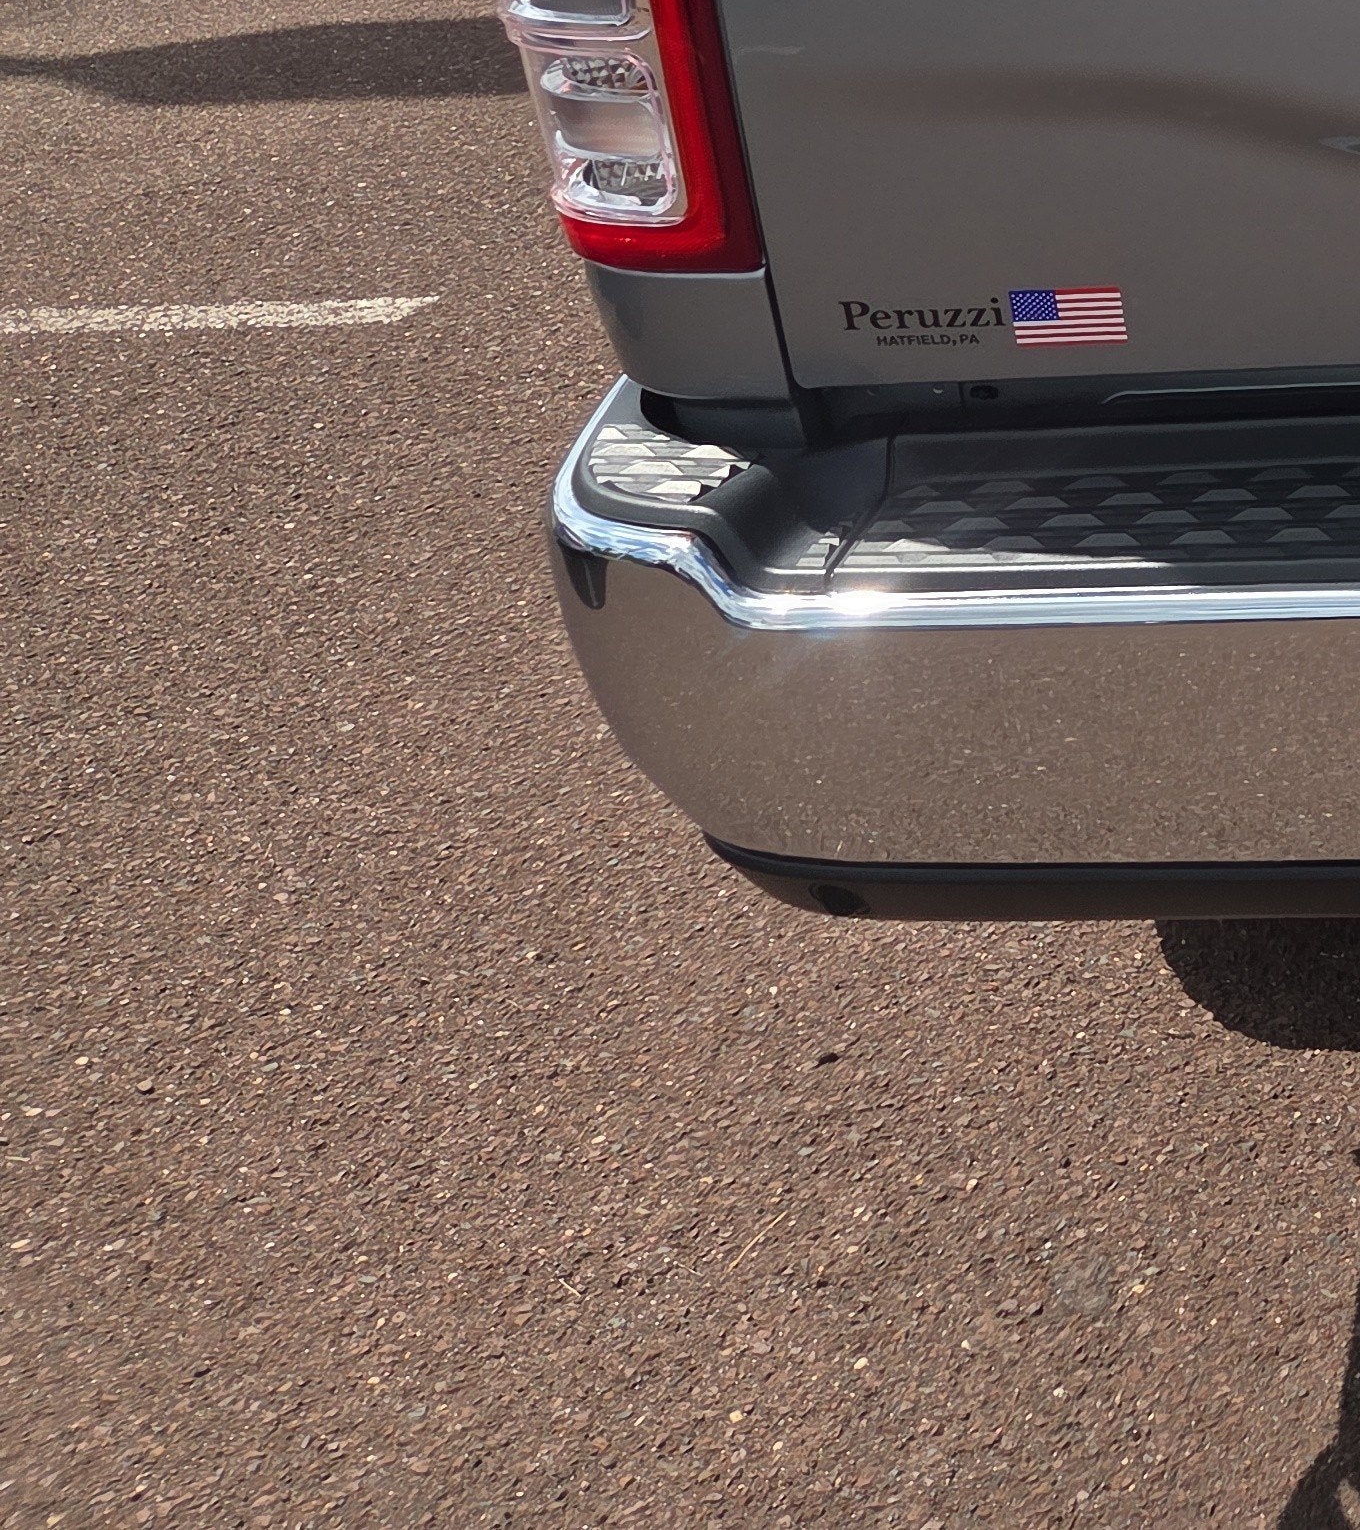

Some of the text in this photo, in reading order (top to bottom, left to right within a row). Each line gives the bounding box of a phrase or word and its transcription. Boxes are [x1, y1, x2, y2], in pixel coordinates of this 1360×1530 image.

[838, 298, 1006, 331] Peruzzi
[876, 333, 981, 347] HATFIELD, PA
